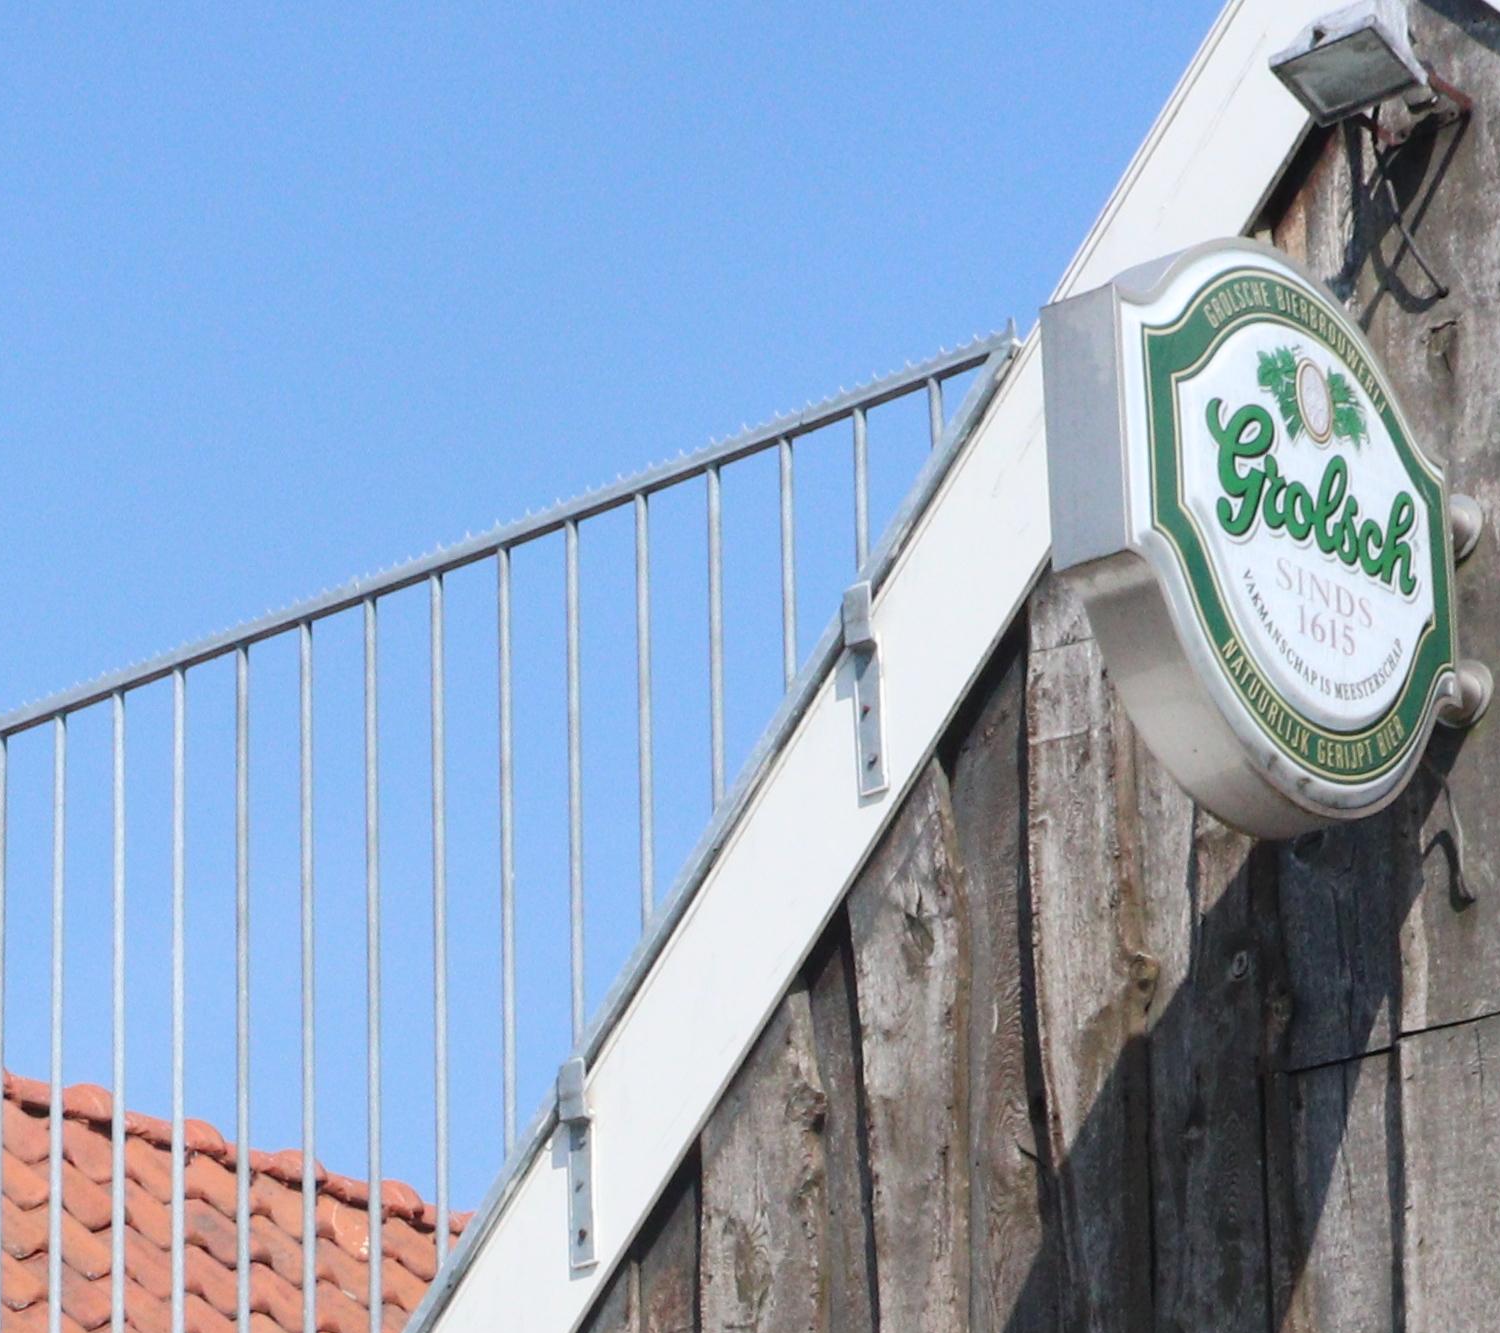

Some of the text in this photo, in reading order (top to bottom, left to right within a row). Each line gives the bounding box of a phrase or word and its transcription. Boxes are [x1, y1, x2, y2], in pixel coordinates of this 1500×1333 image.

[1204, 280, 1389, 414] GROLSCHE BIERBROUWERIJ
[1205, 396, 1418, 598] Grolsch
[1242, 568, 1404, 701] VAKMANSCHAP IS MEESTERSCHAP
[1275, 557, 1373, 630] SINDS
[1297, 604, 1356, 656] 1615
[1221, 637, 1406, 769] NATUURLIJK GERIJPT BIER
